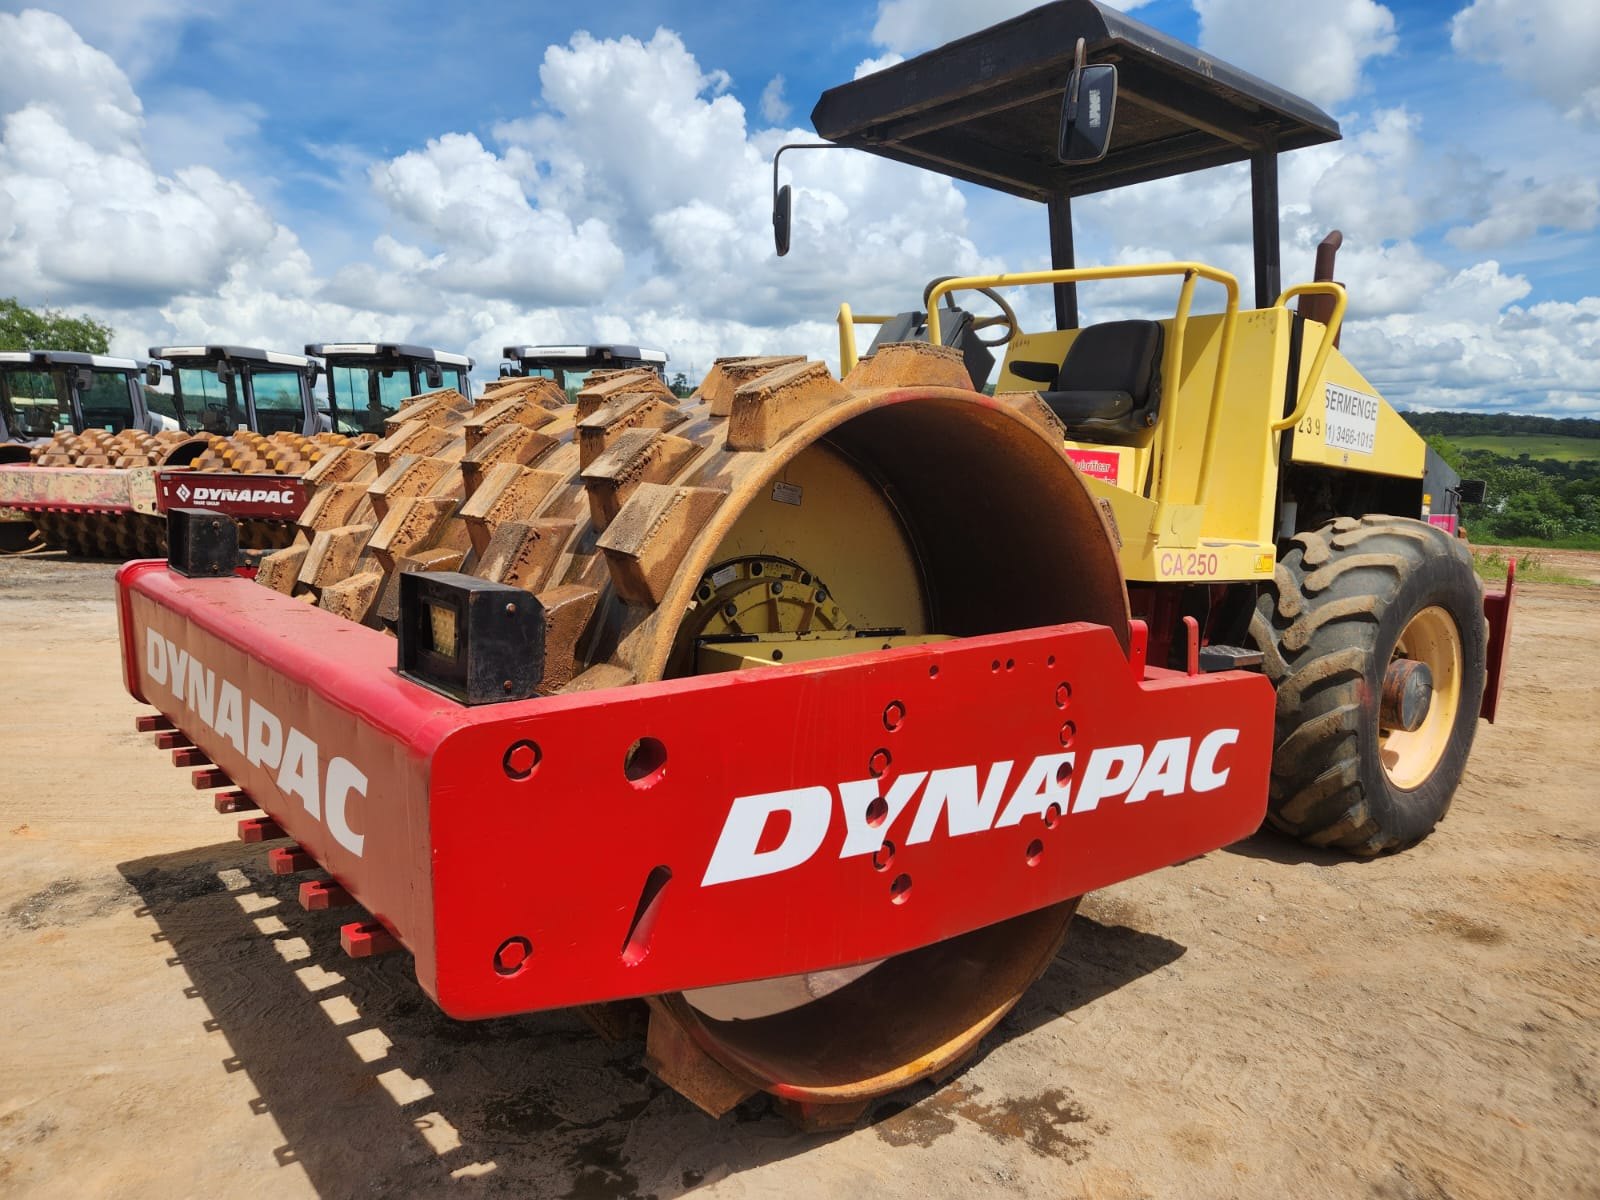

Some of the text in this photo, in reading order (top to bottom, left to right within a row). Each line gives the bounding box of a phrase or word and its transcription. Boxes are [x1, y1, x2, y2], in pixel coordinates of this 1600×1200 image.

[1325, 389, 1378, 421] SERMENGE
[1336, 426, 1374, 449] 3466-1015
[193, 487, 295, 504] DYNAPAC
[146, 627, 368, 858] DYNAPAC
[701, 728, 1240, 887] DYNAPAC
